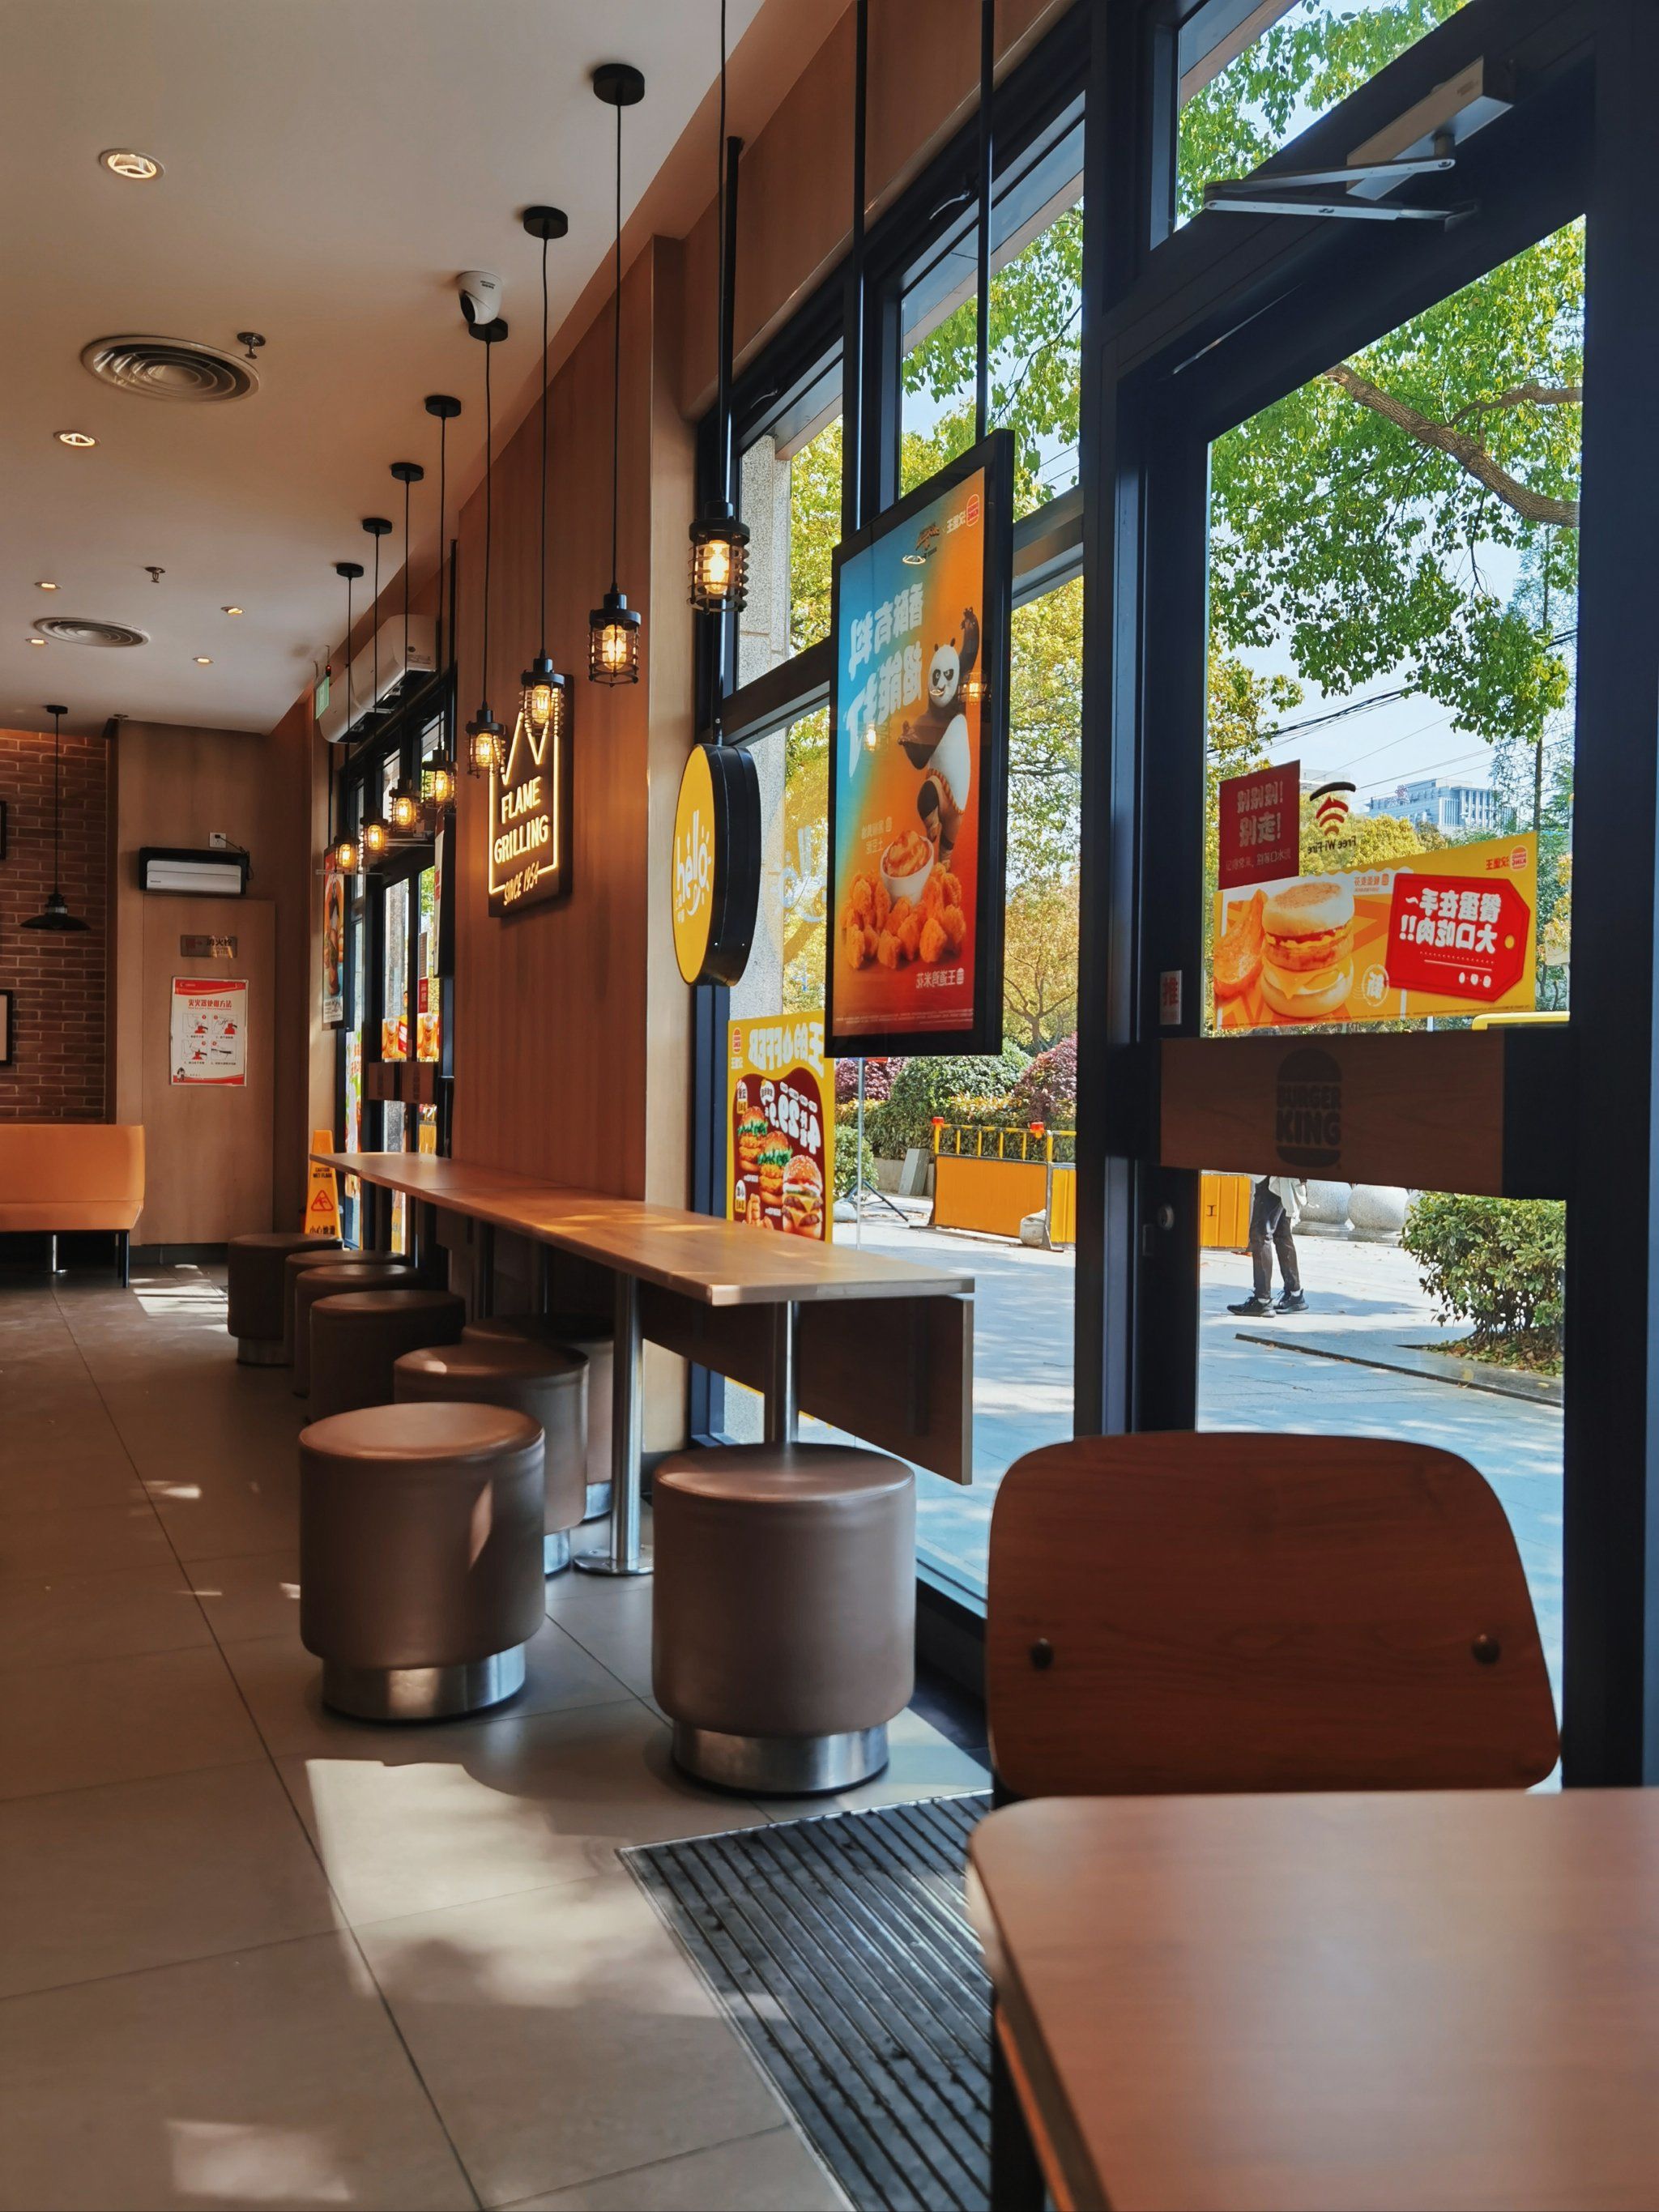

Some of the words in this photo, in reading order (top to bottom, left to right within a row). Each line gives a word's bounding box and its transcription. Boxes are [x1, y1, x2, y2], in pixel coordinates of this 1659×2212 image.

[501, 775, 542, 825] FLAME
[493, 814, 549, 863] GRILLING
[676, 810, 709, 905] hello
[502, 870, 523, 906] SINCE
[523, 860, 539, 893] 1954
[1162, 976, 1179, 1007] 推
[1276, 1084, 1342, 1110] BURGER
[1276, 1110, 1341, 1146] KING
